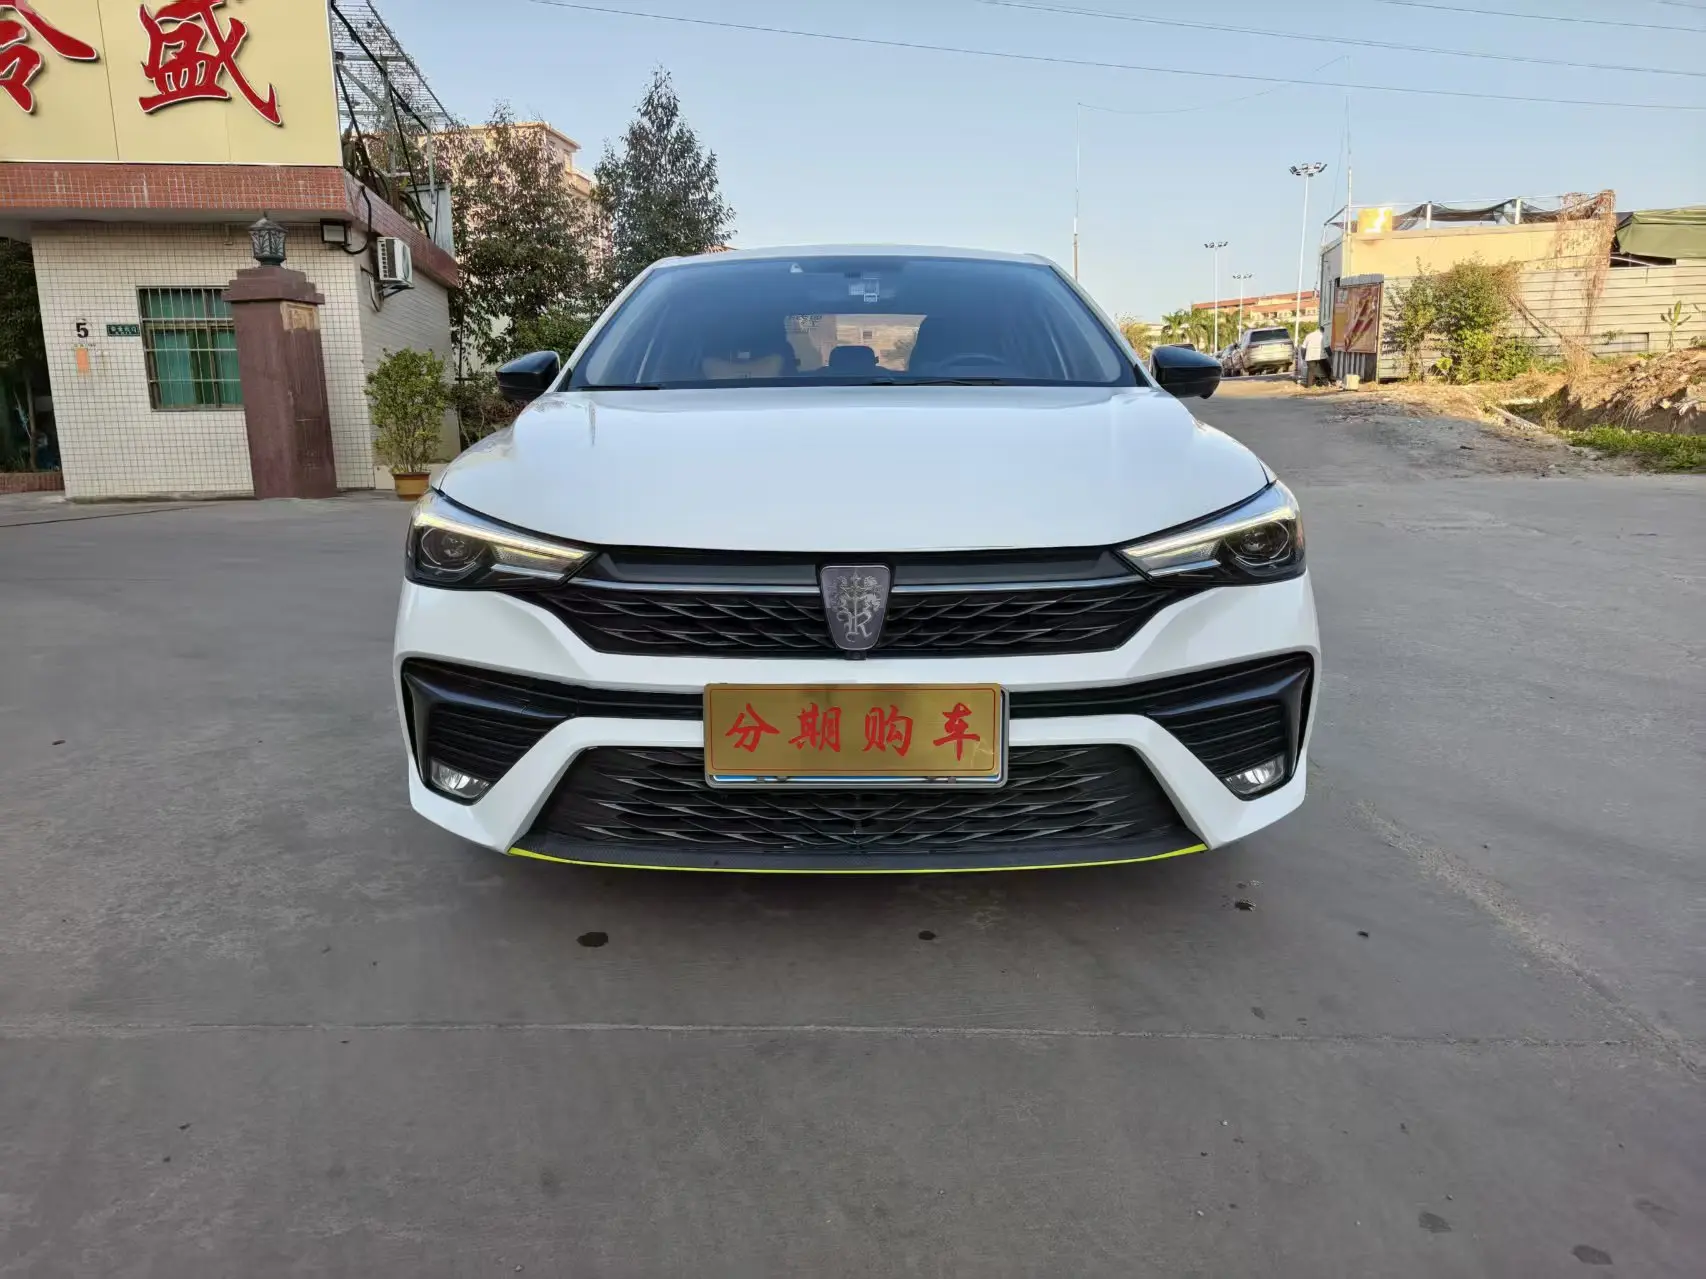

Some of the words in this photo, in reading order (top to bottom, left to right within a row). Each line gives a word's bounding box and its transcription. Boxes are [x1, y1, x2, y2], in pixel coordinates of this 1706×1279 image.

[76, 322, 89, 338] 5
[725, 702, 981, 761] 分期购车
